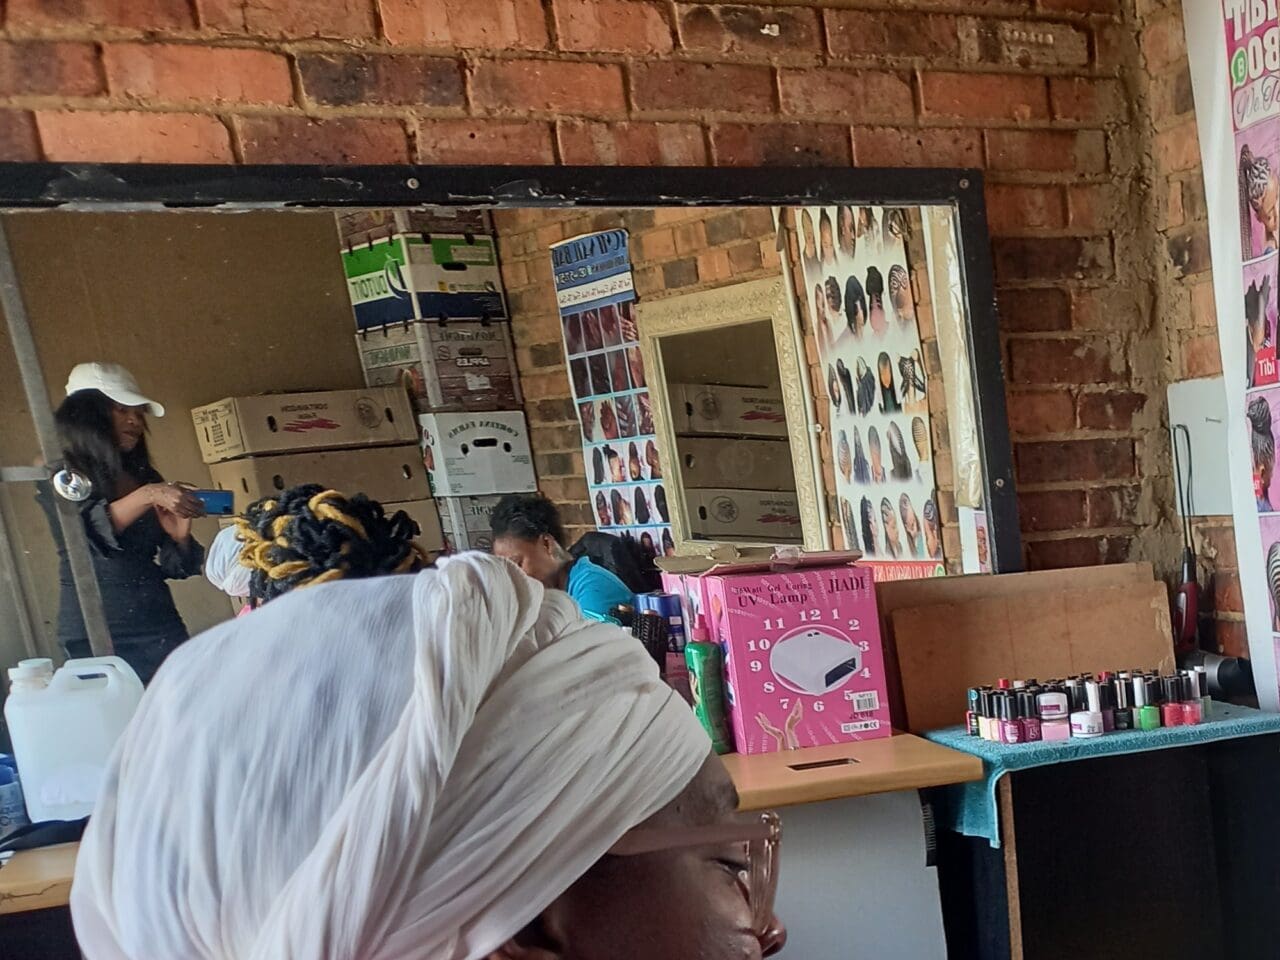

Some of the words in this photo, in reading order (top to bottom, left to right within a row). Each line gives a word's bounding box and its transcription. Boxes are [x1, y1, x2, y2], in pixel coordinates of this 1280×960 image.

[1248, 26, 1280, 80] 08
[1258, 356, 1275, 376] Tibi
[828, 576, 865, 594] JIADI
[738, 595, 760, 608] UV
[771, 593, 808, 605] Lamp
[799, 609, 822, 622] 12
[831, 608, 841, 620] 1
[763, 618, 786, 631] 11
[849, 619, 860, 631] 2
[747, 639, 771, 651] 10
[859, 641, 870, 651] 3
[750, 660, 762, 672] 9
[860, 667, 872, 678] 4
[763, 682, 775, 693] 8
[844, 690, 853, 700] 5
[780, 698, 789, 709] 7
[813, 701, 824, 712] 6
